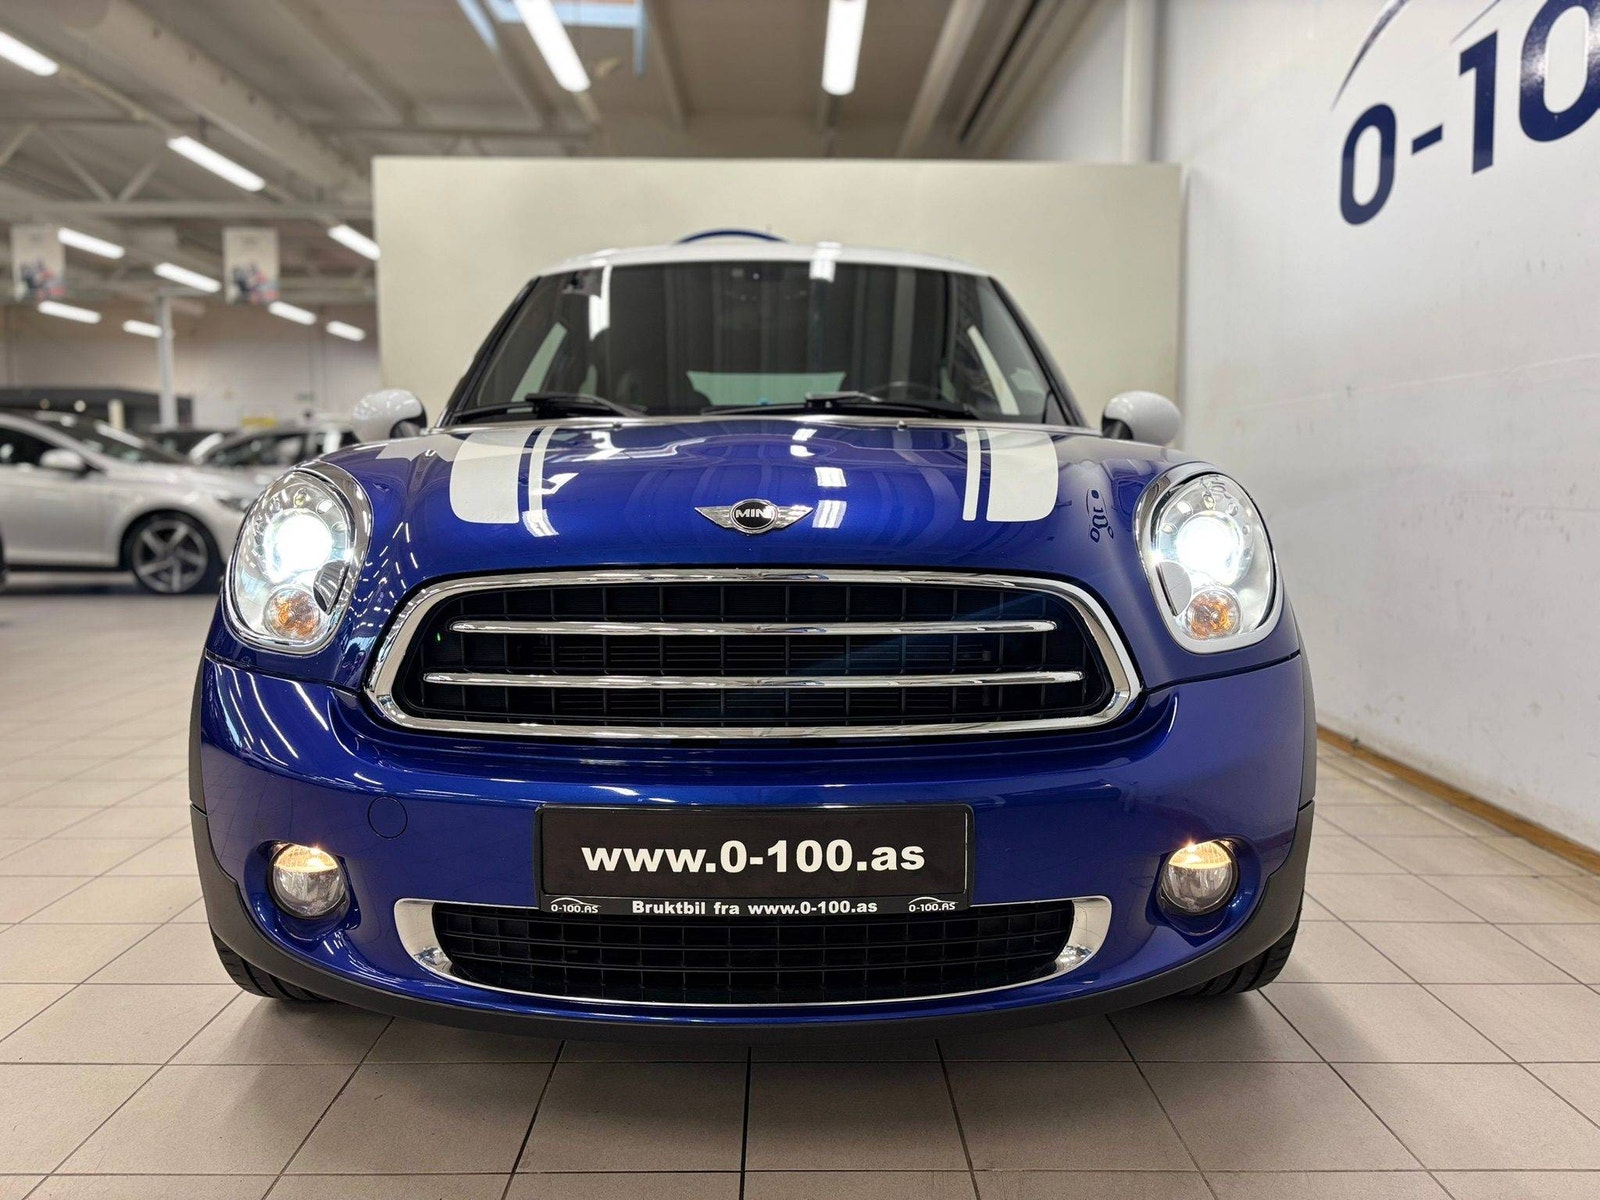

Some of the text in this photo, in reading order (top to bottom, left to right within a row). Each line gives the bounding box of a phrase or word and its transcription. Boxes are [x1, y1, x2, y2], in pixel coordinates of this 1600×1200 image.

[581, 838, 925, 874] www.0-100.as
[550, 904, 599, 914] 0-100.AS
[632, 900, 878, 915] Bruktbil fra www.0-100.as
[908, 902, 956, 912] 0-100.AS
